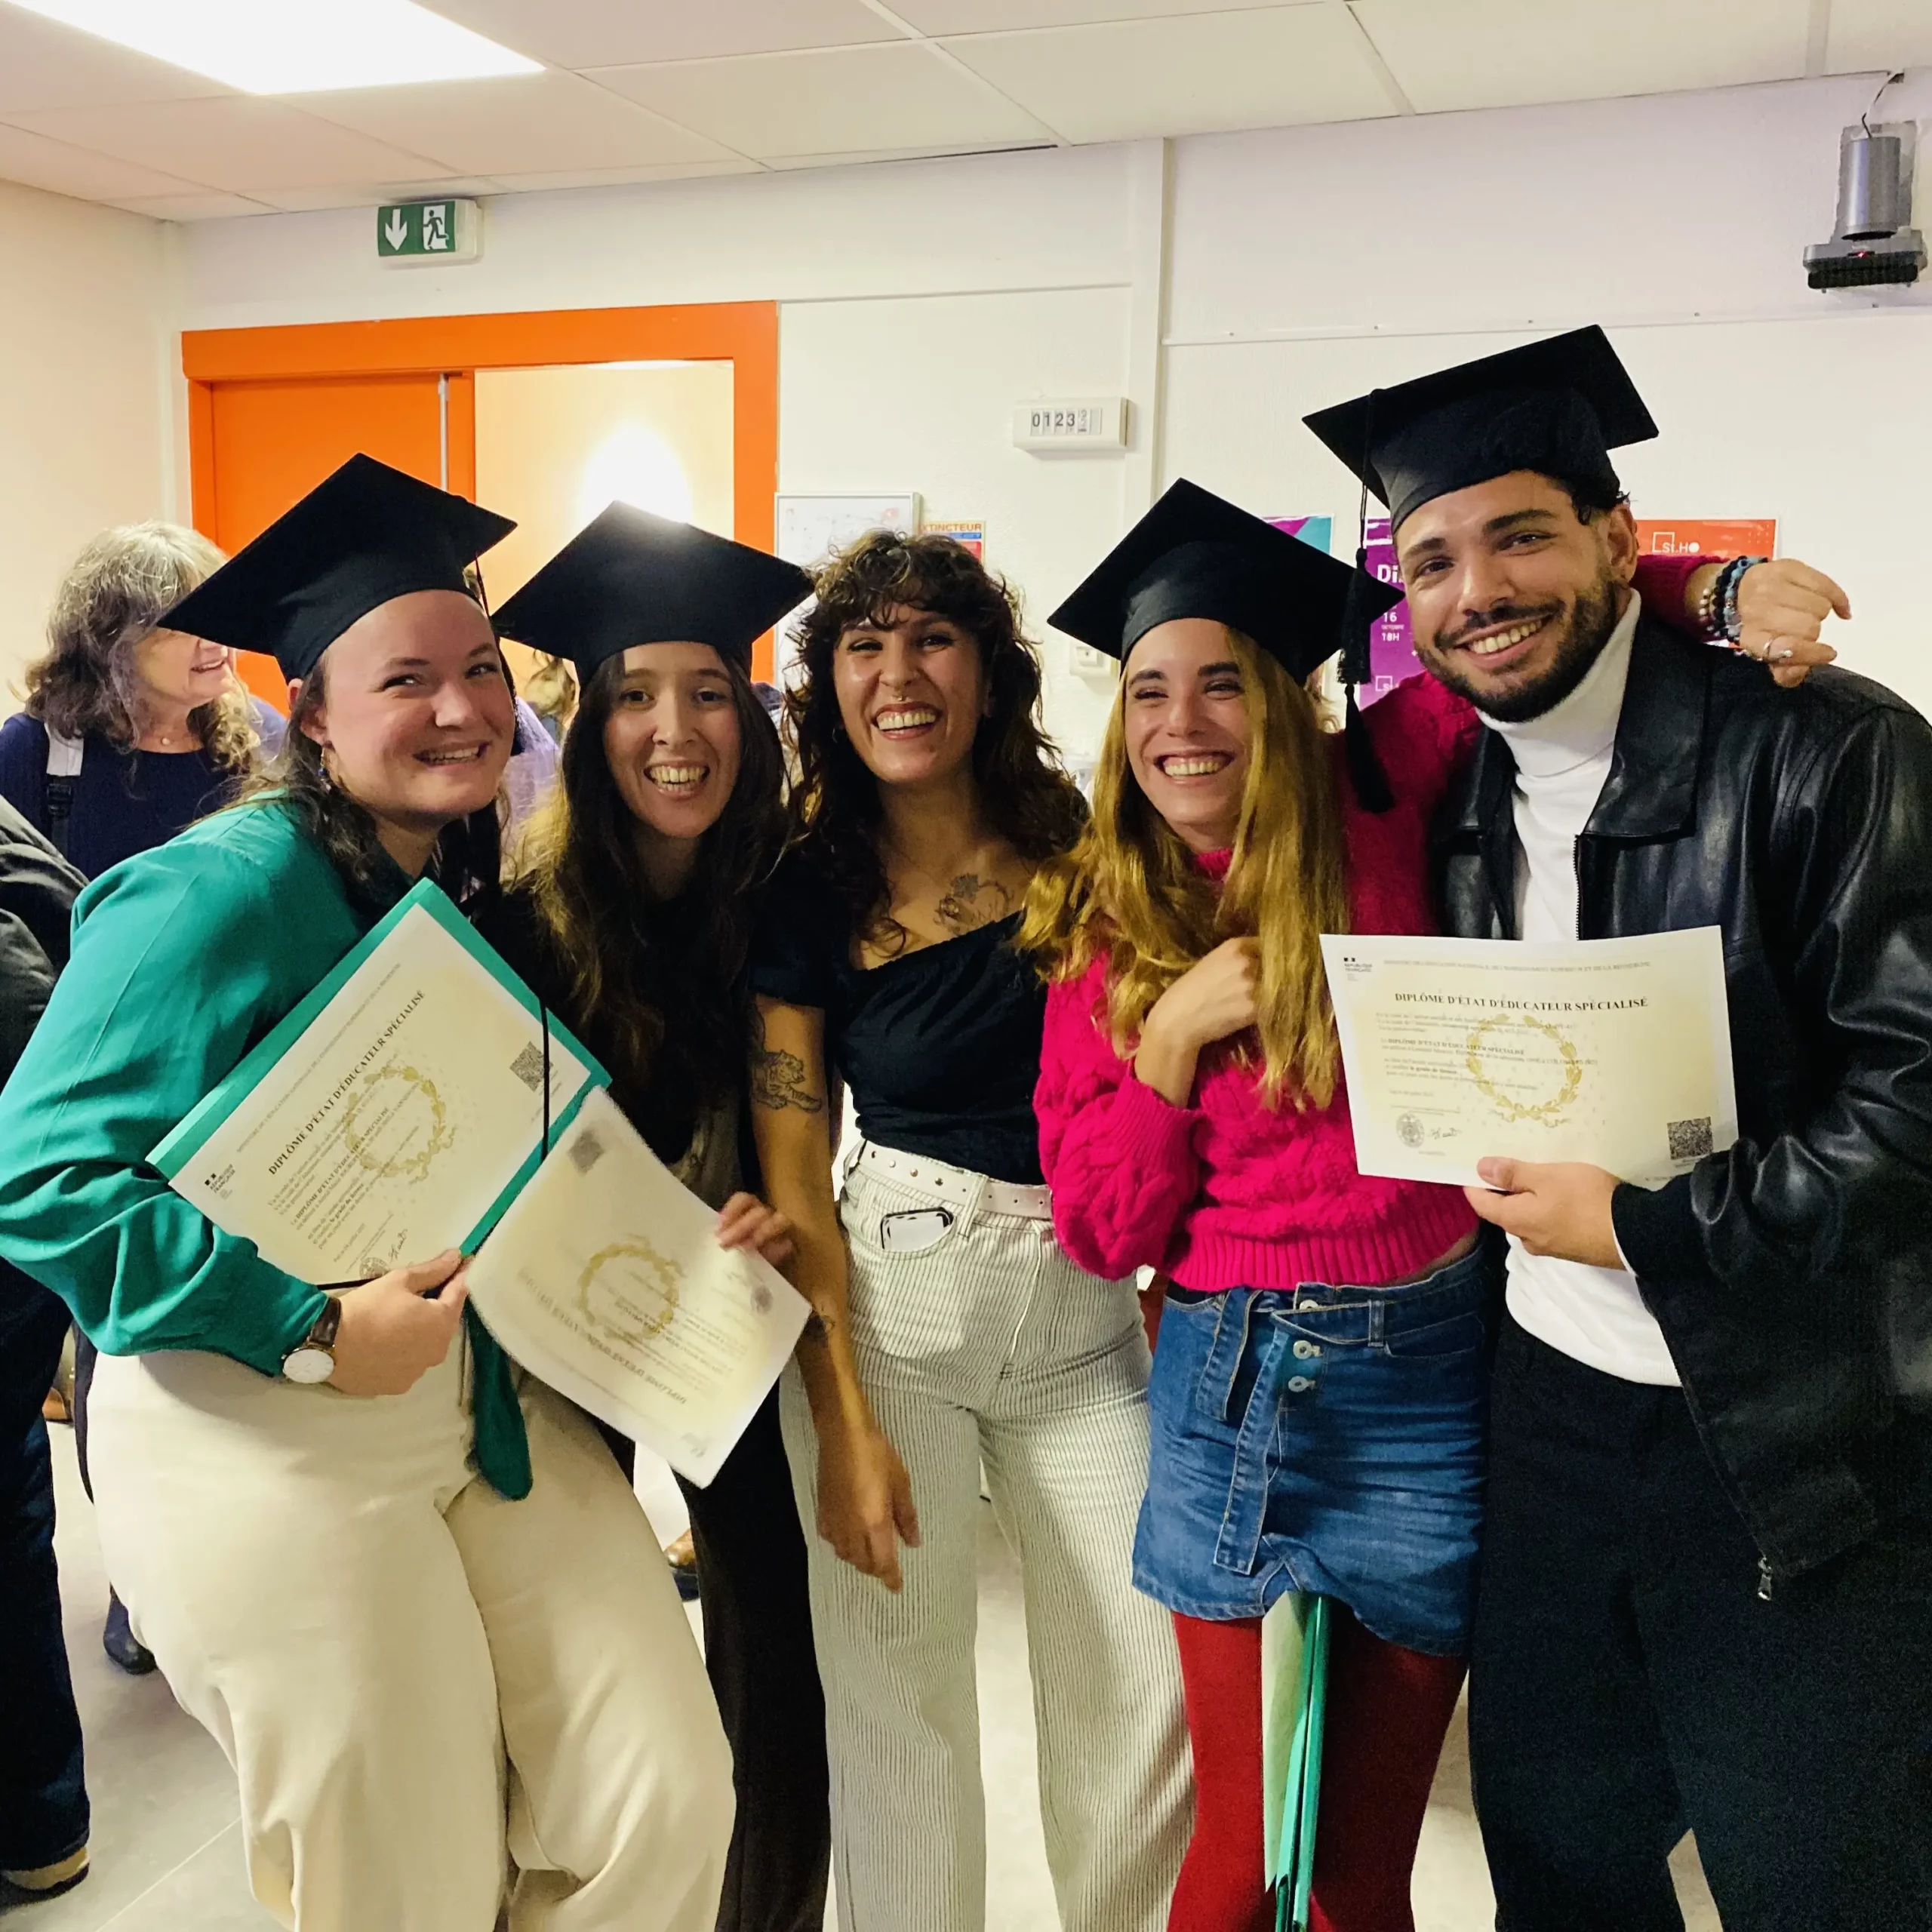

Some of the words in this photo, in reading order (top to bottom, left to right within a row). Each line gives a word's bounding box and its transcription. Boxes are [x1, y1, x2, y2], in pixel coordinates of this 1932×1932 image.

[1377, 564, 1404, 583] Di
[1383, 611, 1397, 623] 16
[1382, 632, 1400, 641] 18H
[1395, 992, 1444, 1004] DIPLÔME
[1447, 994, 1486, 1007] D'ÉTAT
[1489, 998, 1573, 1011] D'ÉDUCATEUR
[1575, 995, 1648, 1011] SPÉCIALISÉ
[268, 1133, 305, 1174] DIPLÔME
[305, 1098, 334, 1131] D'ÉTAT
[333, 1038, 386, 1099] D'ÉDUCATEUR
[383, 989, 426, 1037] SPÉCIALISÉ
